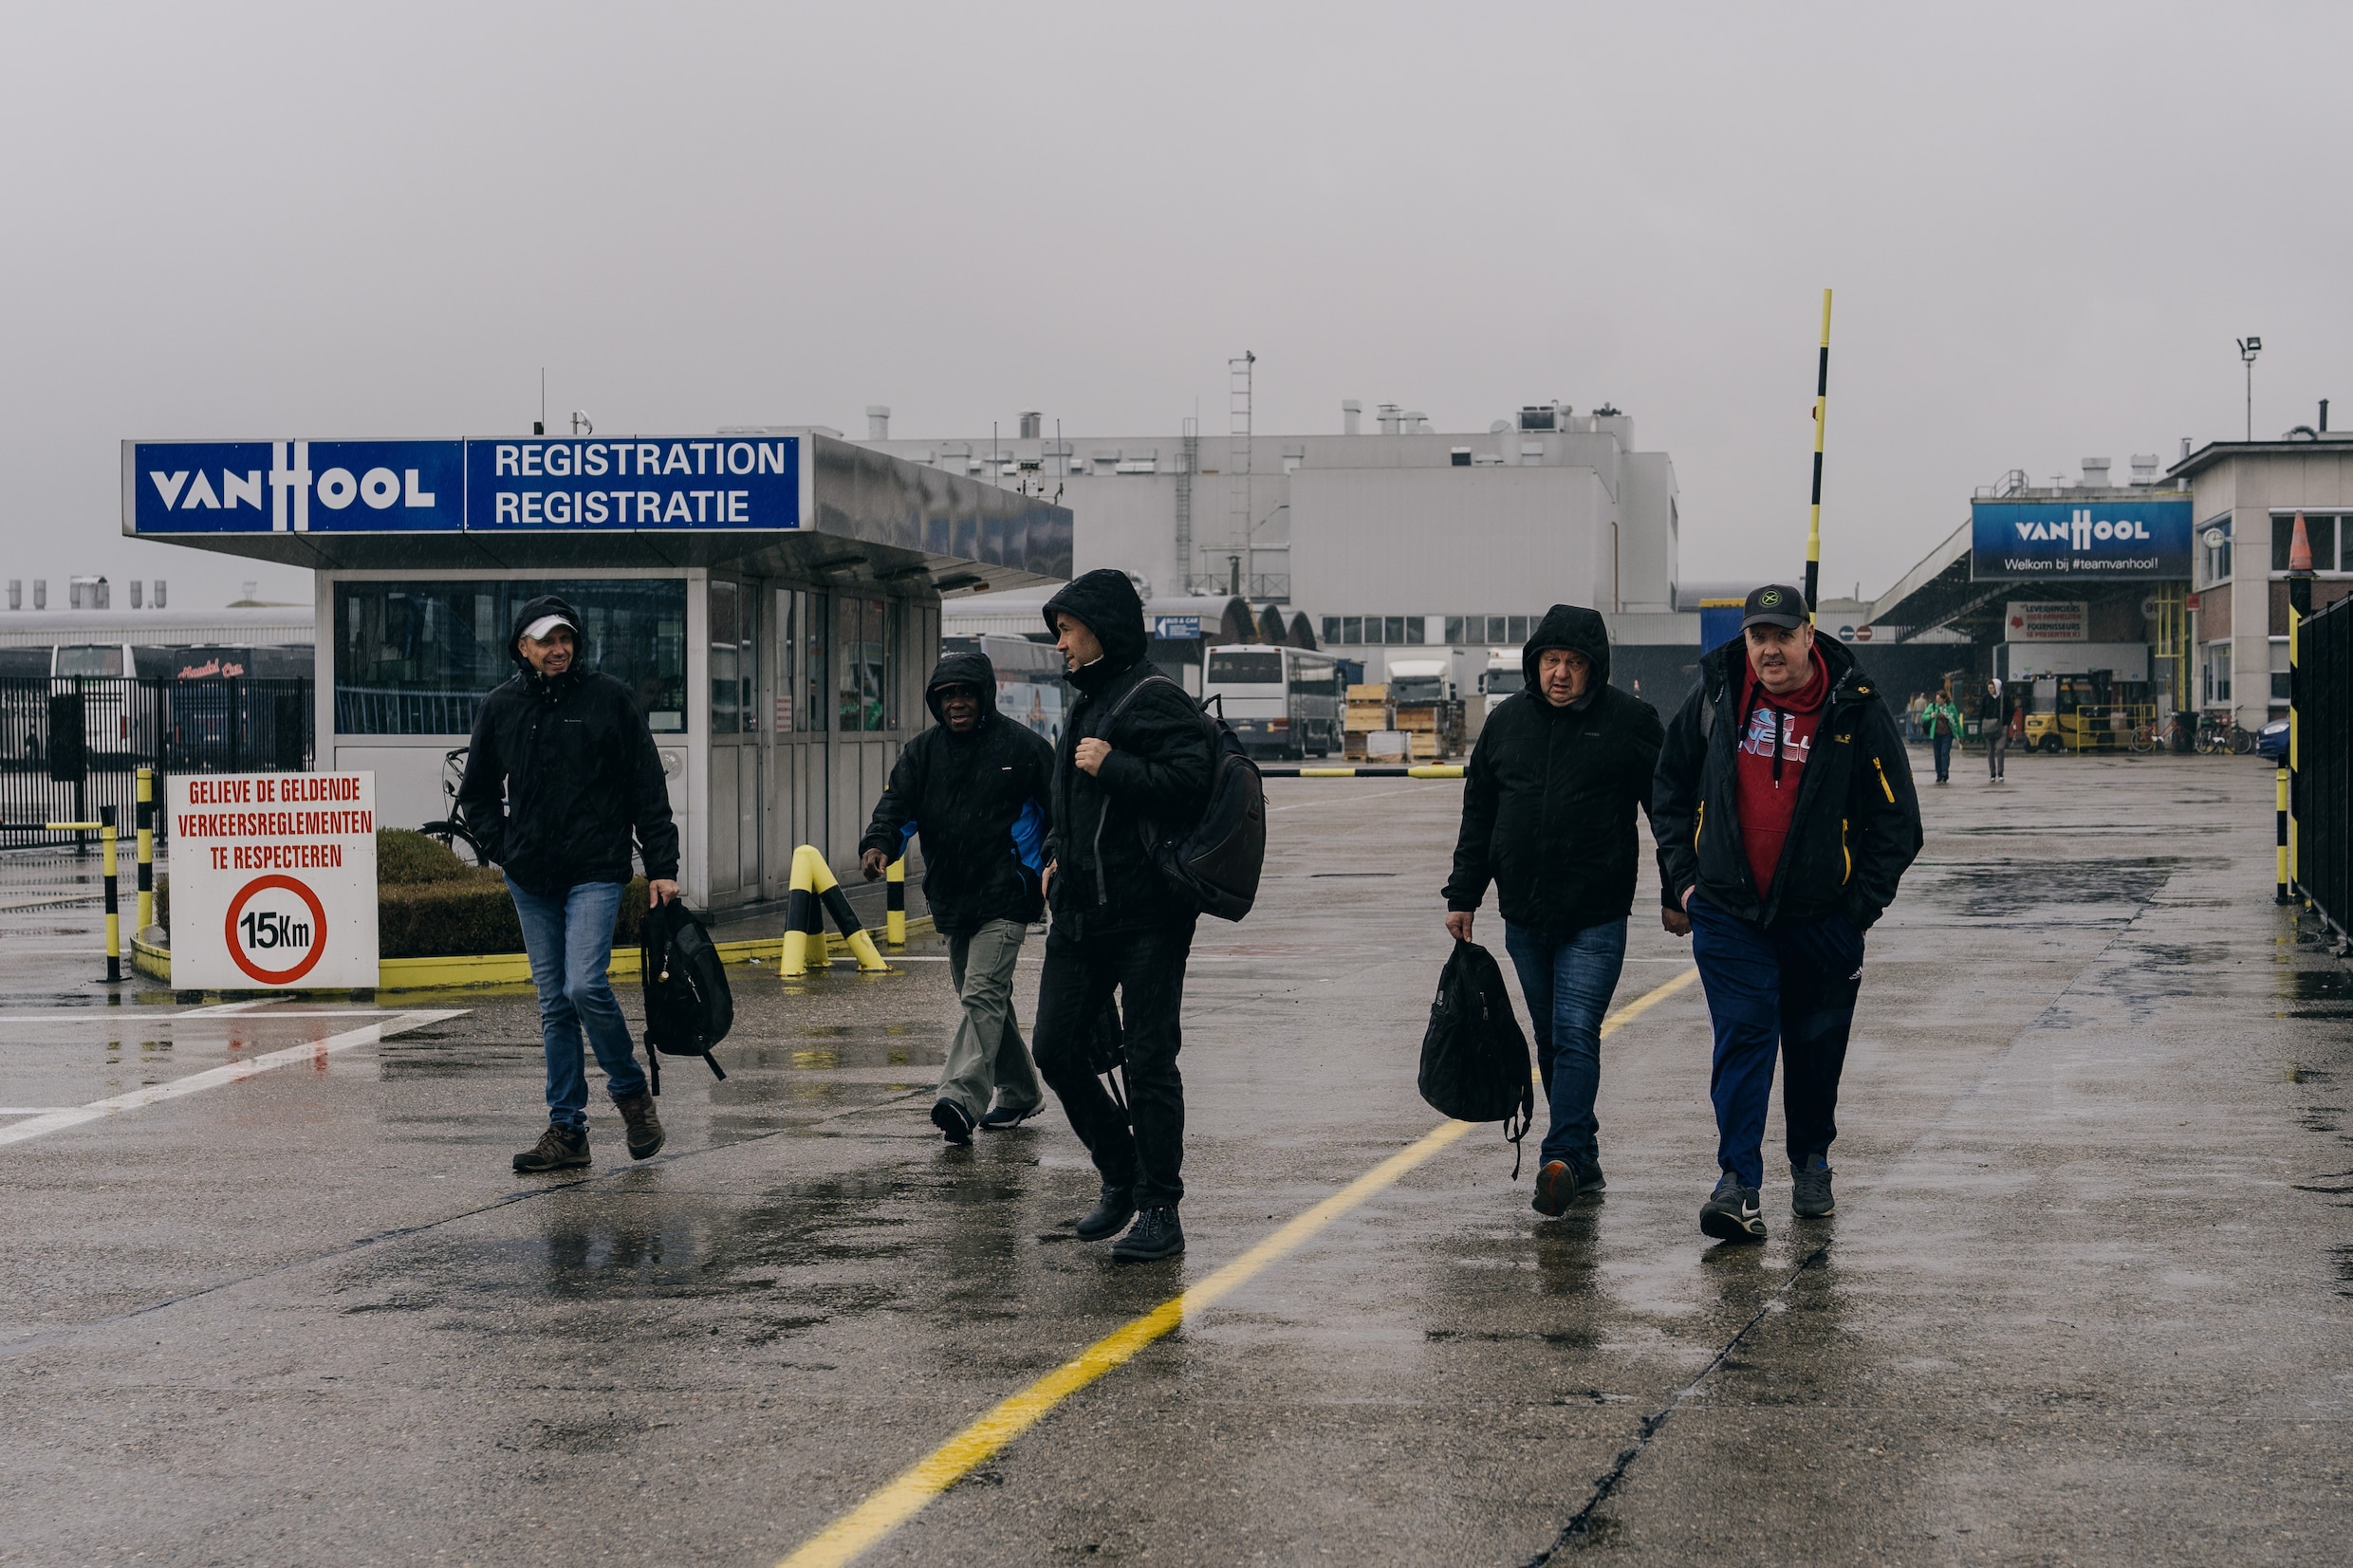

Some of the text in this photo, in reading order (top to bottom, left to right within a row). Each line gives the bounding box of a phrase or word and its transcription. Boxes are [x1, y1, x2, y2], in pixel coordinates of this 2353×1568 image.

[495, 443, 785, 476] REGISTRATION
[495, 489, 750, 524] REGISTRATIE
[2005, 558, 2158, 572] Welkom bij #teamvanhool!
[189, 777, 361, 804] GELIEVE DE GELDENDE
[177, 810, 373, 838] VERKEERSREGLEMENTEN
[211, 844, 343, 870] TE RESPECTEREN
